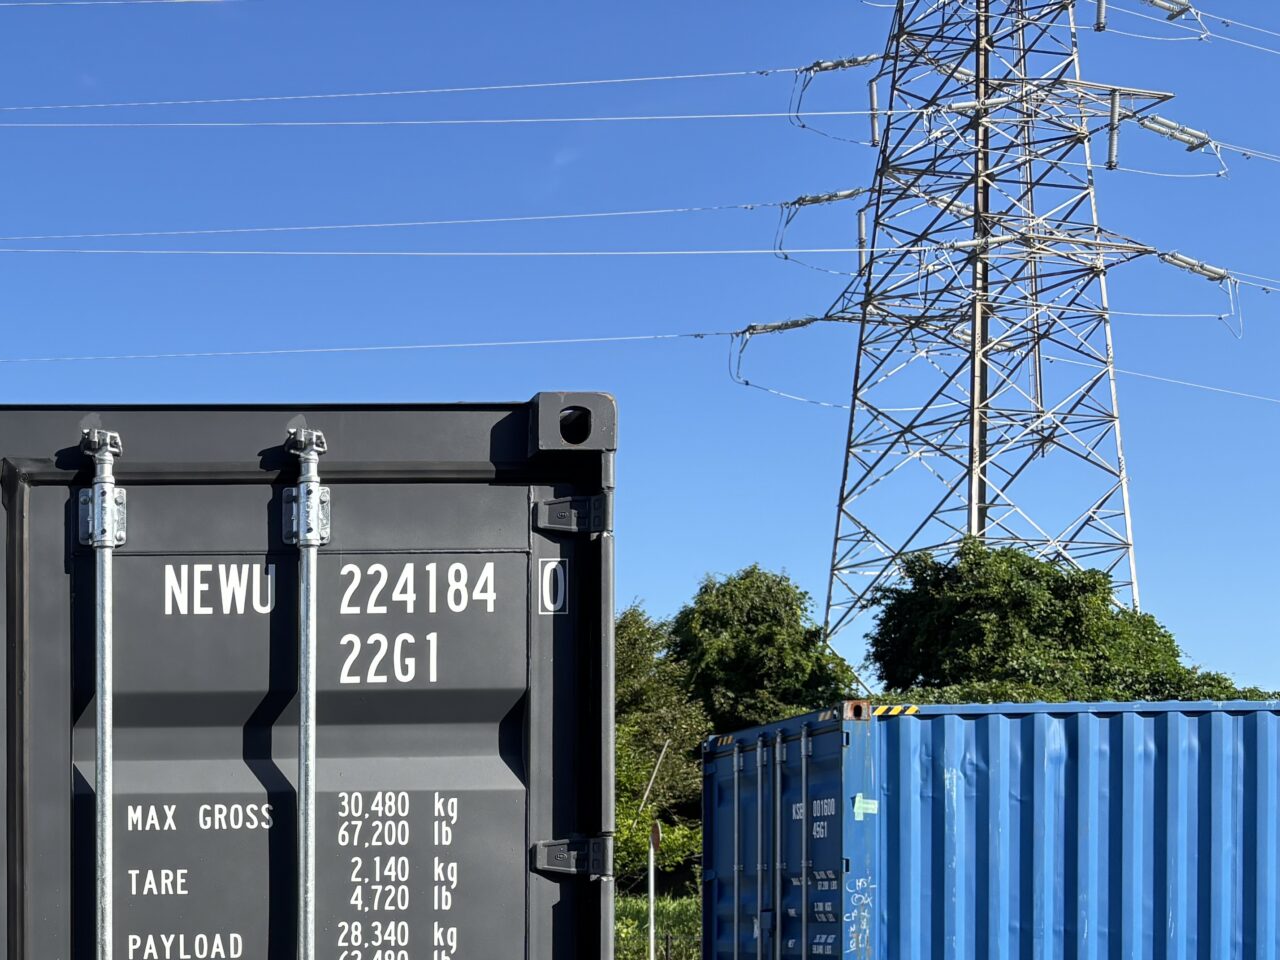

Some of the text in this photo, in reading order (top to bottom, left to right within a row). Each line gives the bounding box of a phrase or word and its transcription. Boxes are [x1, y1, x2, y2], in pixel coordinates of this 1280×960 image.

[165, 562, 565, 615] NEWU 224184 0
[340, 631, 437, 683] 22G1
[127, 804, 273, 831] MAX GROSS
[338, 791, 458, 825] 30,480 kg
[338, 820, 453, 848] 67,200 lb
[128, 869, 189, 896] TARE
[351, 856, 458, 889] 2,140 kg
[350, 885, 452, 913] 4,720 lb
[128, 933, 243, 960] PAYLOAD
[337, 921, 457, 954] 28,340 kg
